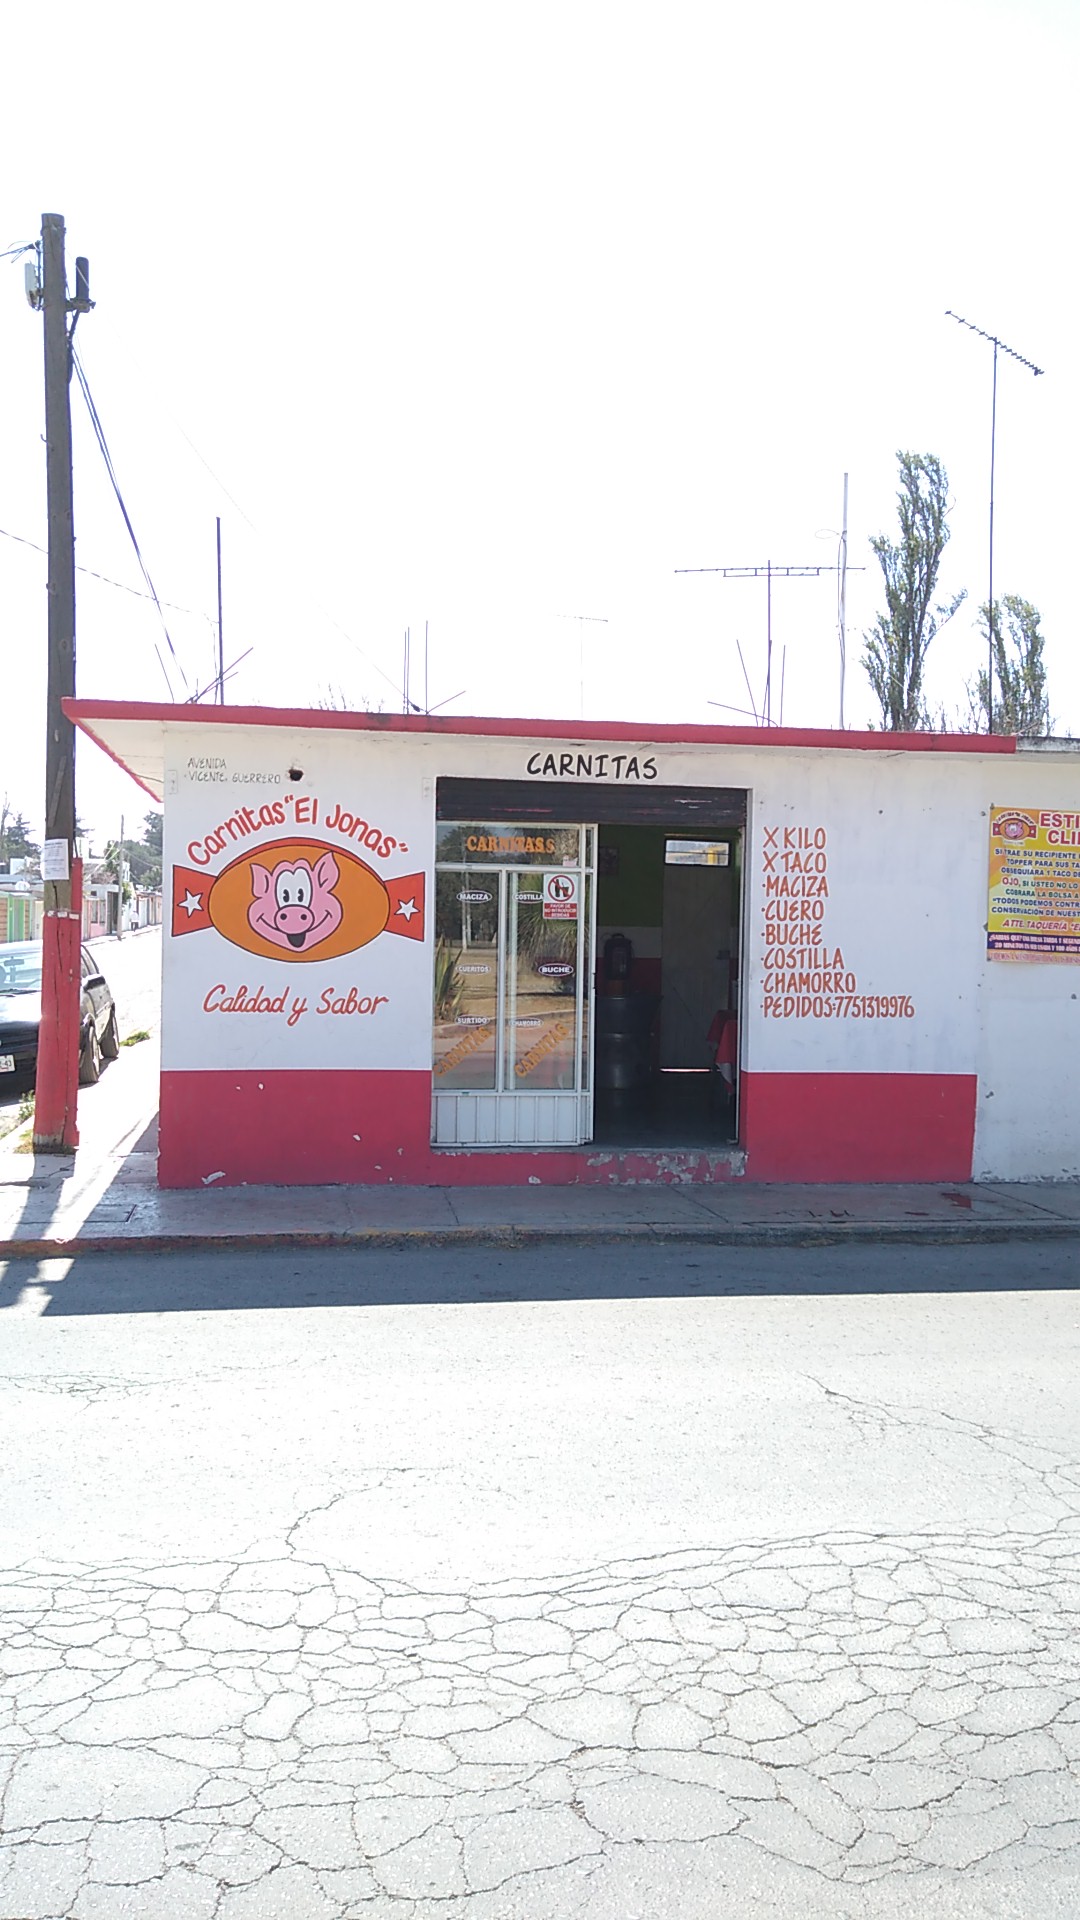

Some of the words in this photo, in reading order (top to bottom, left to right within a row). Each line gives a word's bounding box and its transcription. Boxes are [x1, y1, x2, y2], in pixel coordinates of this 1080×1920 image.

[187, 757, 227, 769] AVENIDA
[526, 752, 658, 780] CARNITAS
[232, 773, 281, 784] GUERRERO
[187, 801, 286, 866] Carnitas
[762, 826, 780, 849] X
[783, 826, 827, 850] KILO
[762, 851, 779, 873] X
[781, 851, 827, 874] TACO
[1007, 858, 1033, 866] TOPPER
[1034, 851, 1076, 859] RECIPIENTE
[1001, 867, 1044, 876] OBSEQUIARA
[459, 893, 489, 901] MACIZA
[765, 875, 829, 898] MACIZA
[1005, 888, 1035, 897] COBRARA
[764, 900, 824, 922] CUERO
[1020, 899, 1053, 907] PODEMOS
[765, 923, 823, 945] BUCHE
[763, 947, 845, 970] COSTILLA
[763, 972, 856, 993] CHAMORRO
[203, 984, 289, 1014] Calidad
[286, 997, 308, 1027] y
[316, 987, 390, 1015] Sabor
[457, 1016, 488, 1025] SURTIDO
